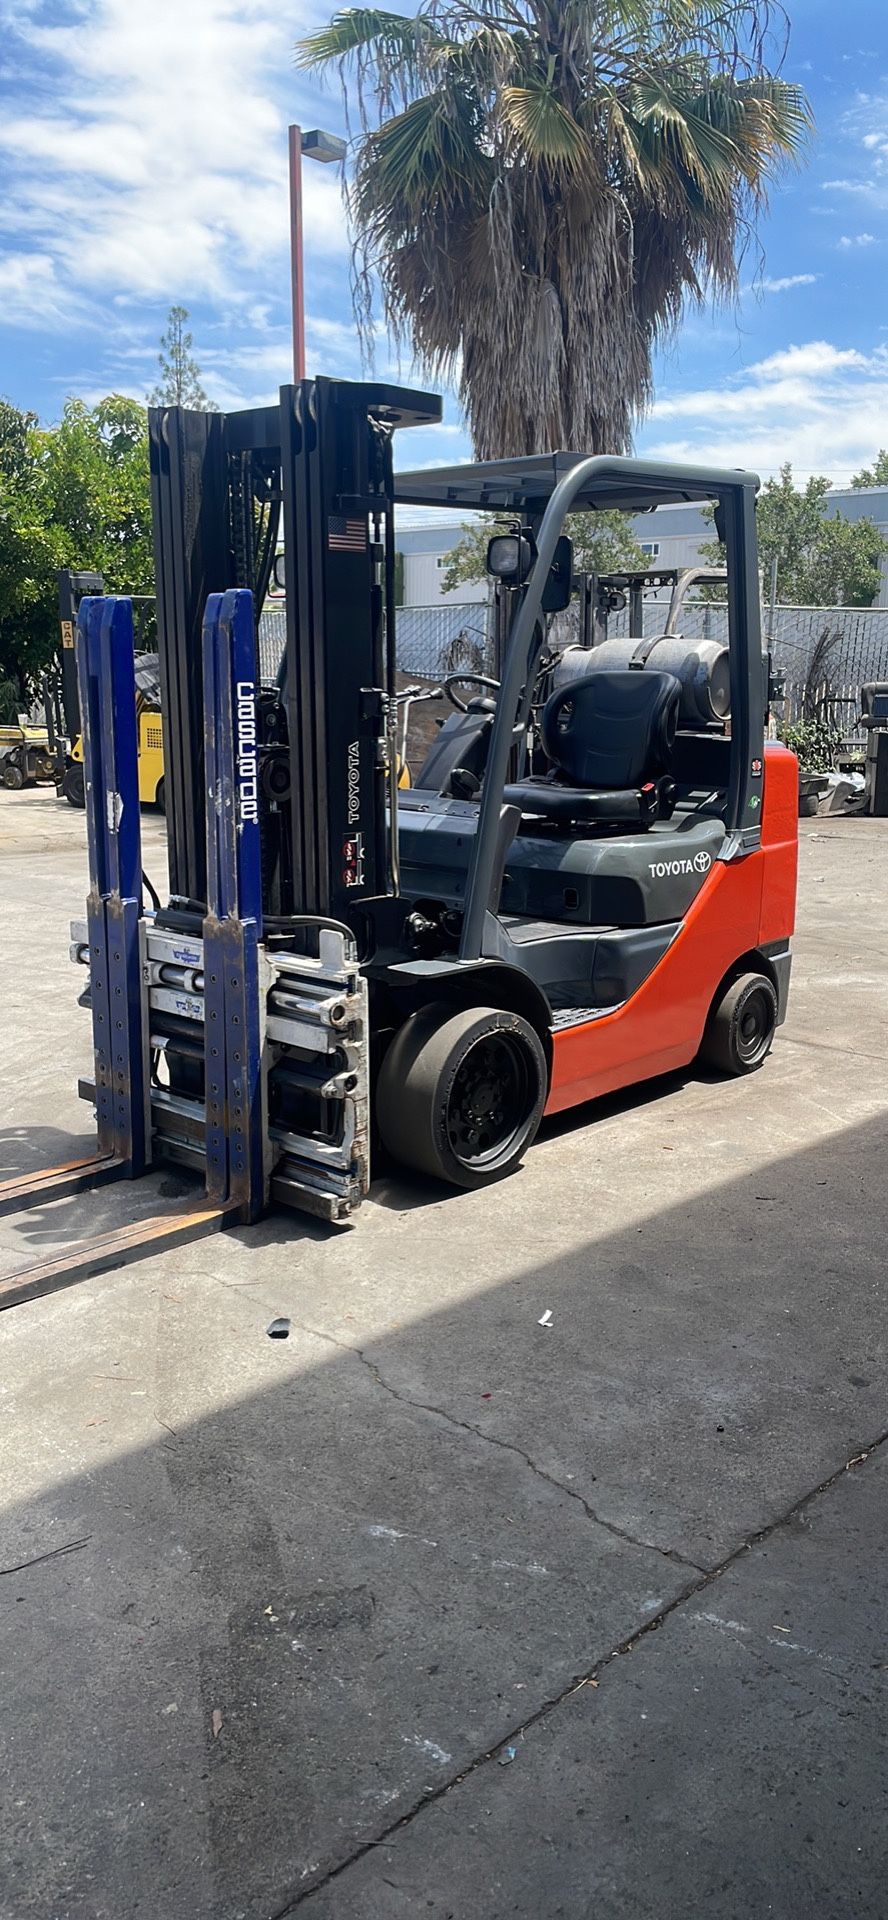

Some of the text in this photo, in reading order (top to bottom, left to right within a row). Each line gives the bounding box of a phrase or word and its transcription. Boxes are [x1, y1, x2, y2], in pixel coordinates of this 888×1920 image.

[63, 622, 72, 647] CAT
[347, 741, 360, 824] TOYOTA
[648, 859, 694, 878] TOYOTA
